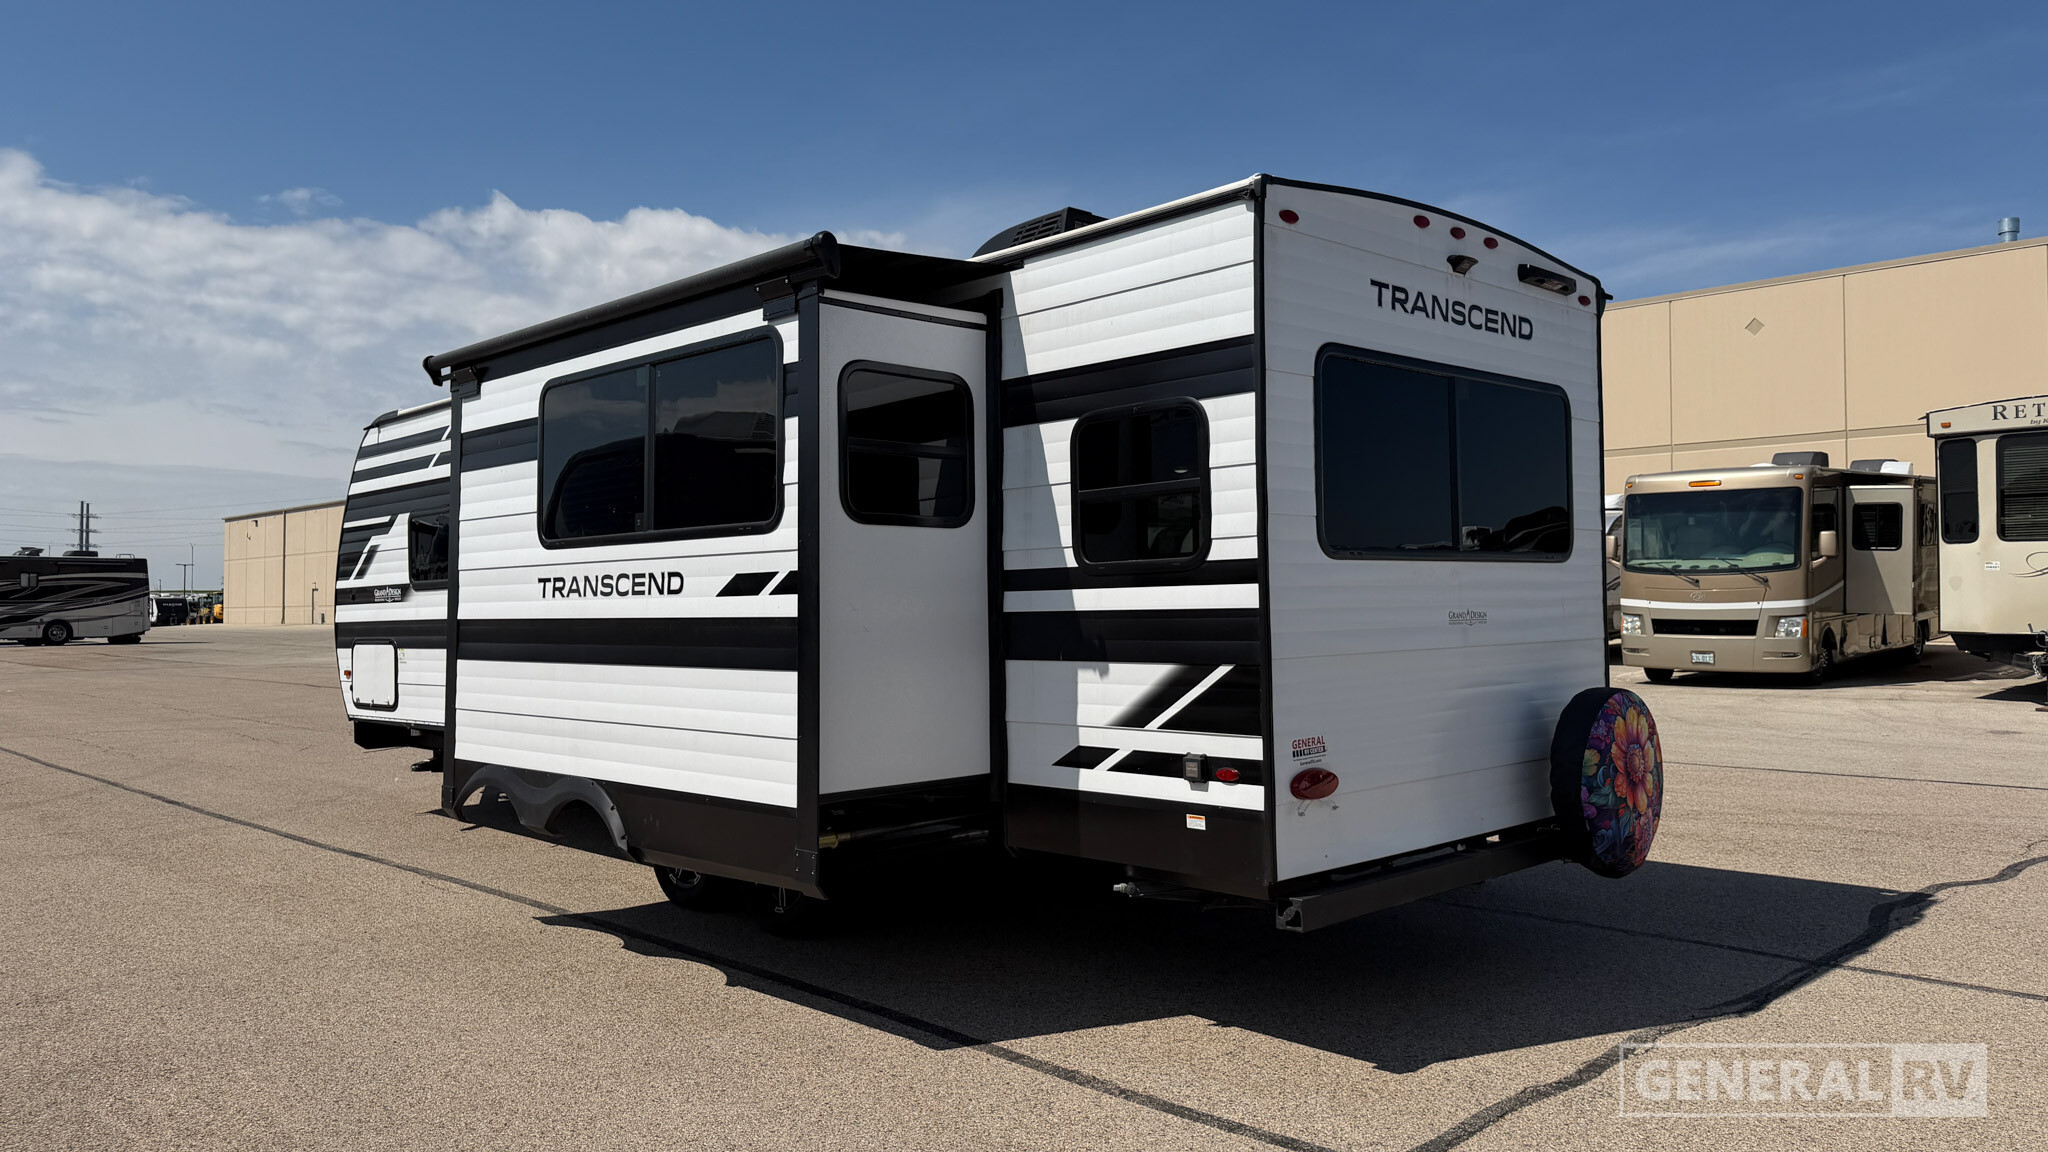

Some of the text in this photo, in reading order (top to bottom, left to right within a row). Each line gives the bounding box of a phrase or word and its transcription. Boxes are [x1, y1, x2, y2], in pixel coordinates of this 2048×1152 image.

[1370, 278, 1533, 340] TRANSCEND
[538, 571, 684, 598] TRANSCEND
[1292, 736, 1325, 749] GENERAL
